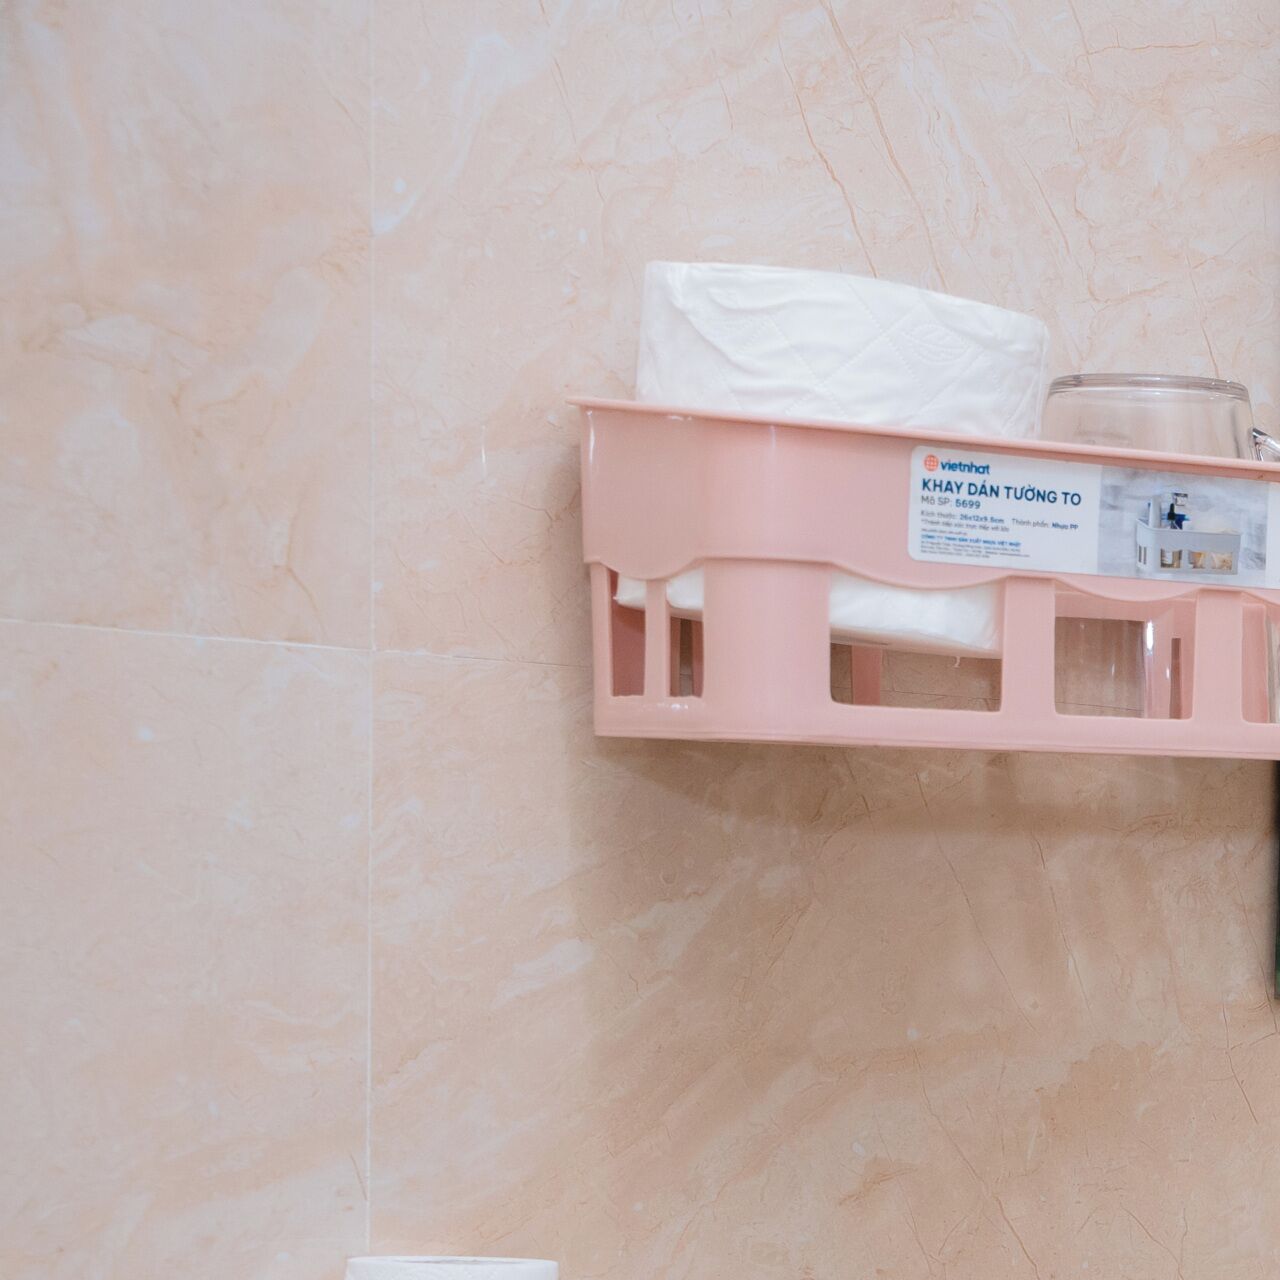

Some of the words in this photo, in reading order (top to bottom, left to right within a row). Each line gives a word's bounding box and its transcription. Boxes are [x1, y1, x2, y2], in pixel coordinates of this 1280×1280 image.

[940, 460, 990, 475] vietnhat
[922, 478, 963, 495] KHAY
[967, 480, 1000, 499] DÁN
[1004, 484, 1057, 504] TƯỜNG
[1061, 492, 1082, 506] TO
[955, 499, 981, 510] 5699
